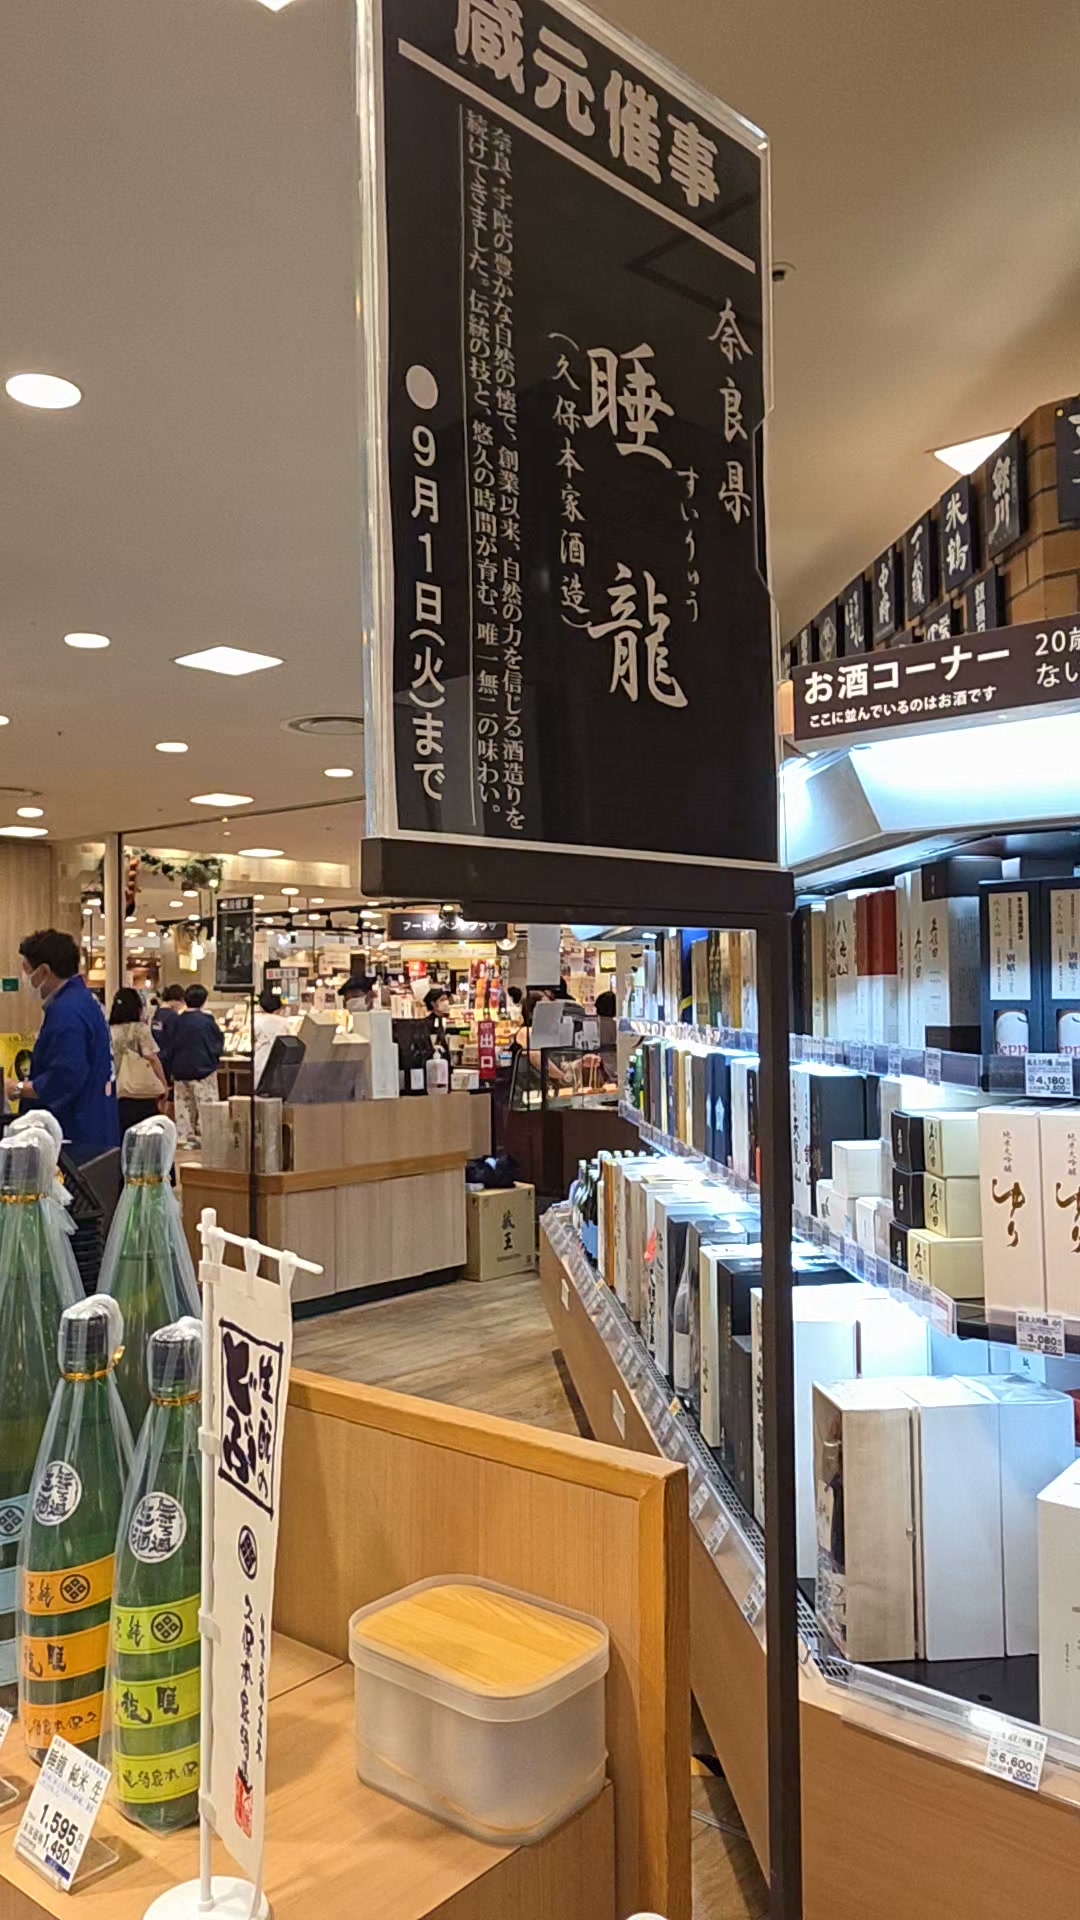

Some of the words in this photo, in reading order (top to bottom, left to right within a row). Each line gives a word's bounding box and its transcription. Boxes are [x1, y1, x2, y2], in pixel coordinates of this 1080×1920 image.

[454, 0, 720, 207] 蔵元催事
[708, 298, 754, 525] 奈良県
[583, 343, 688, 708] 睡龍
[676, 466, 700, 623] すいりゅう
[804, 645, 1010, 704] お酒コーナー
[809, 685, 998, 729] ここに並んでいるのはお酒です
[480, 1033, 494, 1069] 出口
[992, 1178, 1026, 1248] ゆり
